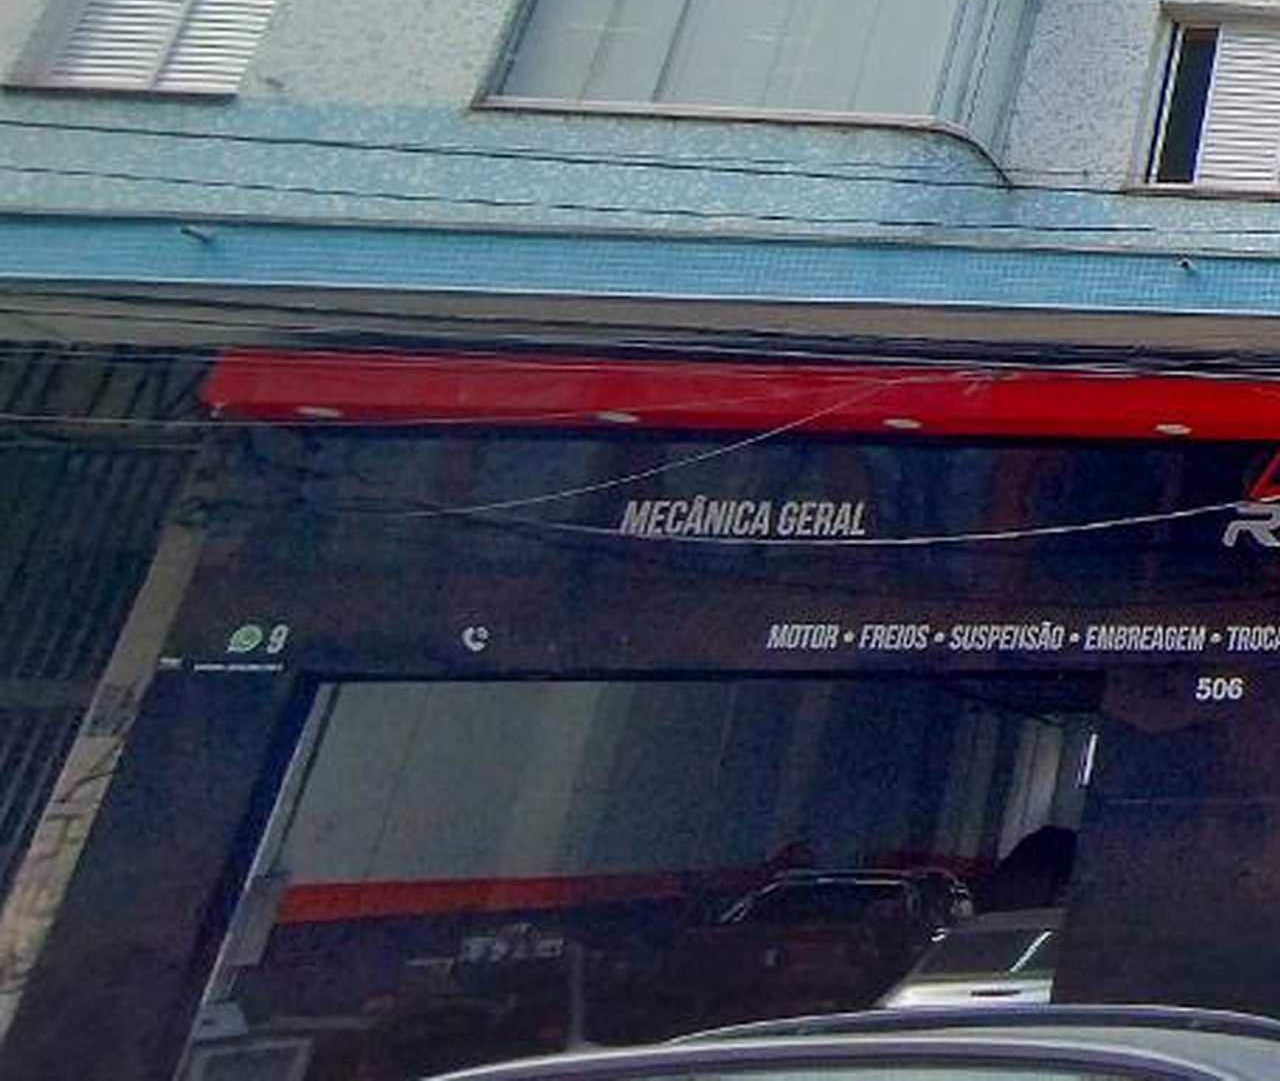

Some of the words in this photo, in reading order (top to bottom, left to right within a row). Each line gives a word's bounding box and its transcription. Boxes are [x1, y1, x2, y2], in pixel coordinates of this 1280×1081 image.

[619, 494, 772, 536] MECÂNICA
[776, 501, 866, 536] GERAL
[766, 624, 839, 649] MOTOR
[859, 624, 930, 649] FREIOS
[950, 621, 1064, 650] SUSPENSÃO
[1083, 625, 1205, 651] EMBREAGEM
[1195, 677, 1244, 700] 506
